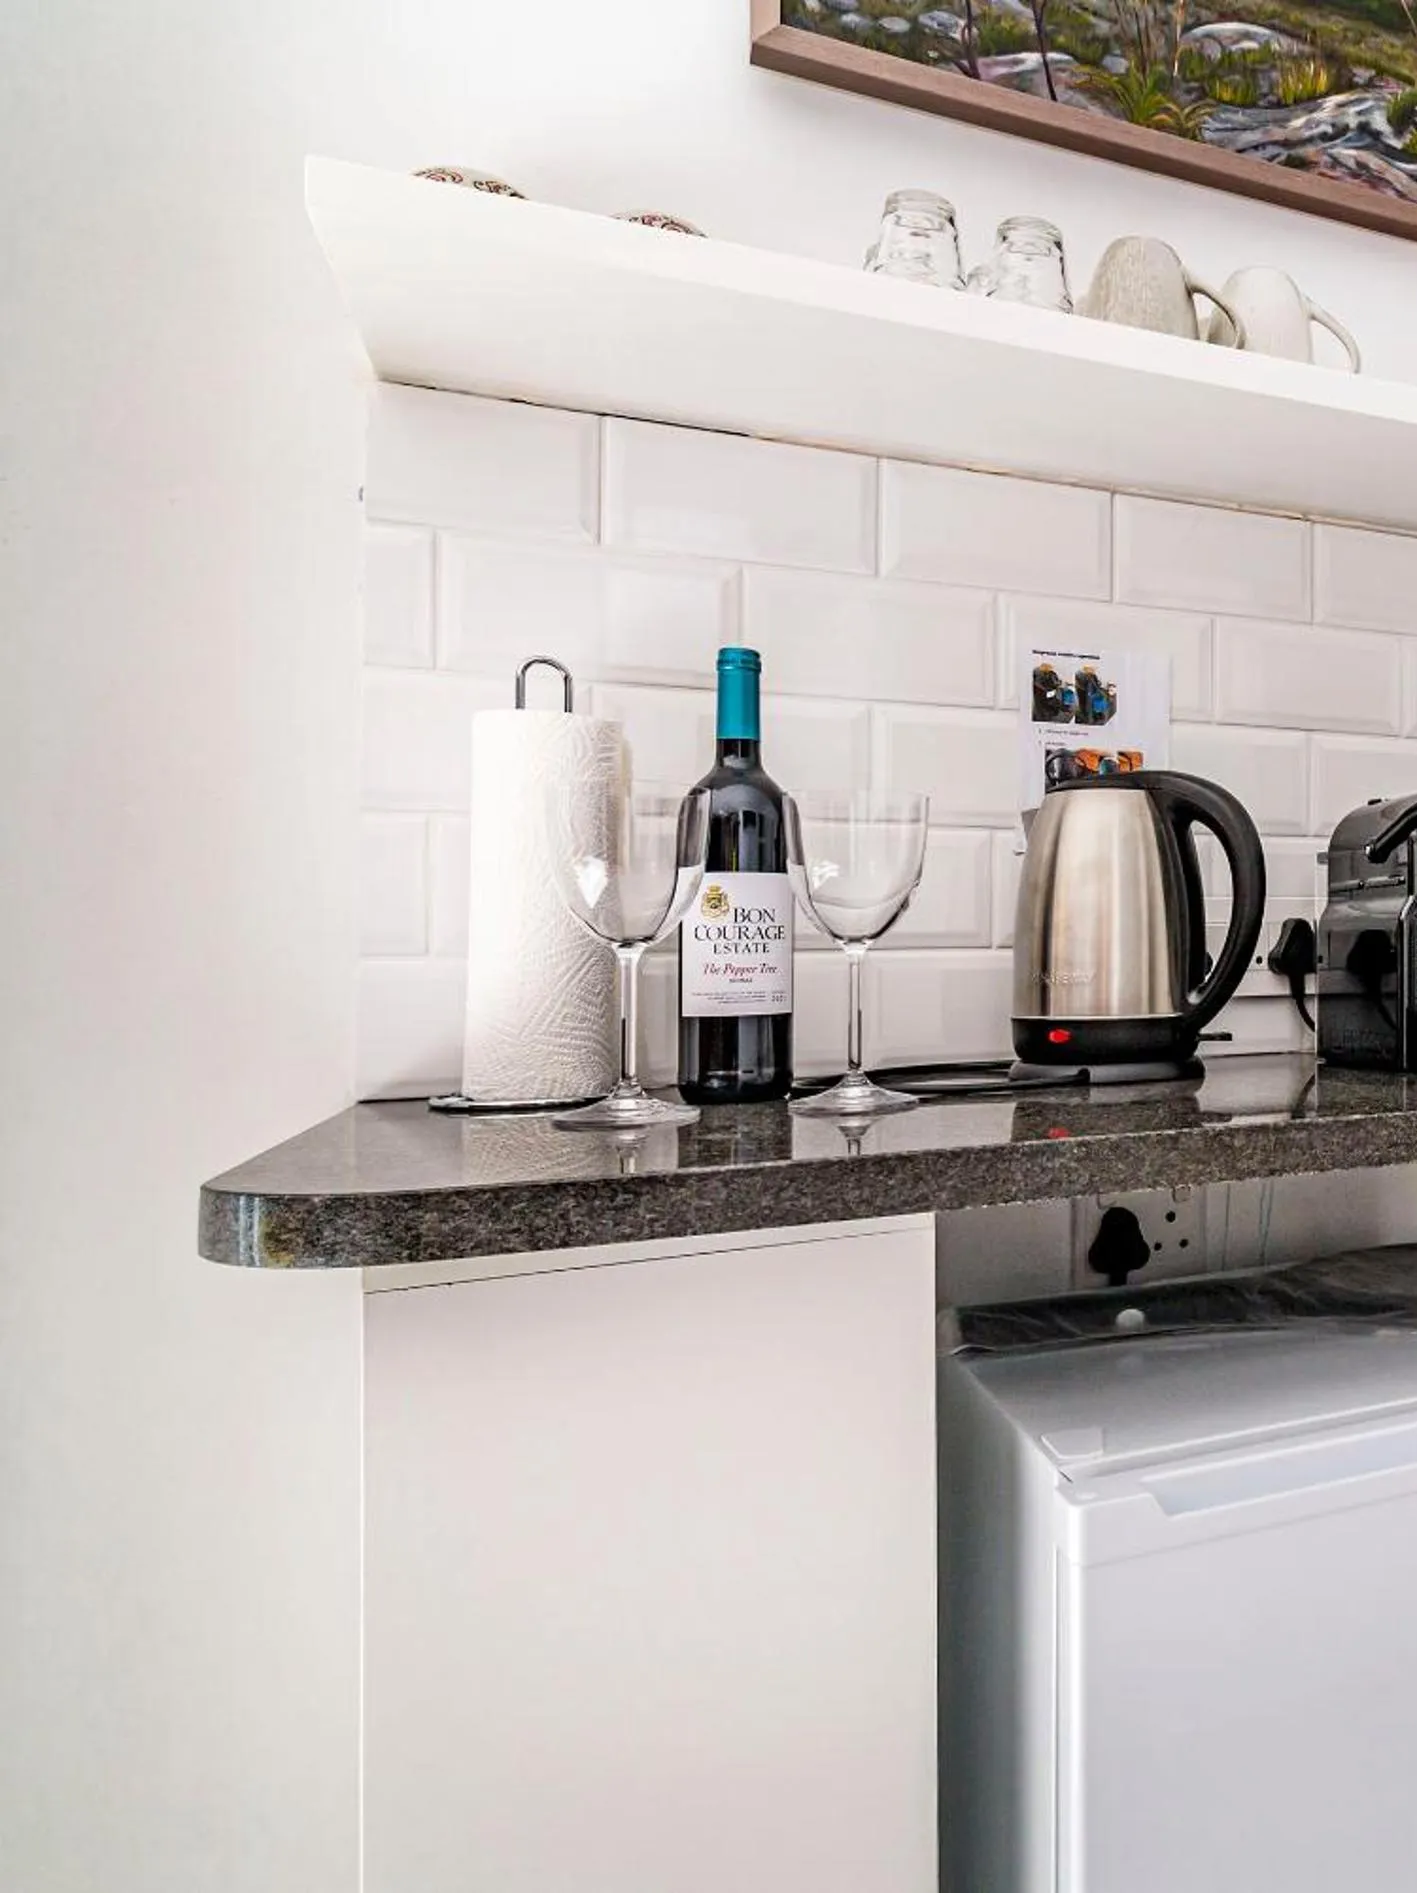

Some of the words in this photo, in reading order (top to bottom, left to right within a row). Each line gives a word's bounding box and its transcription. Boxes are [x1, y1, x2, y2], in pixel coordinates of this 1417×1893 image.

[733, 907, 776, 924] BON
[693, 924, 786, 942] COURAGE
[712, 942, 770, 955] ESTATE
[703, 963, 719, 975] The
[723, 962, 758, 976] Pepper
[759, 962, 778, 974] Tree
